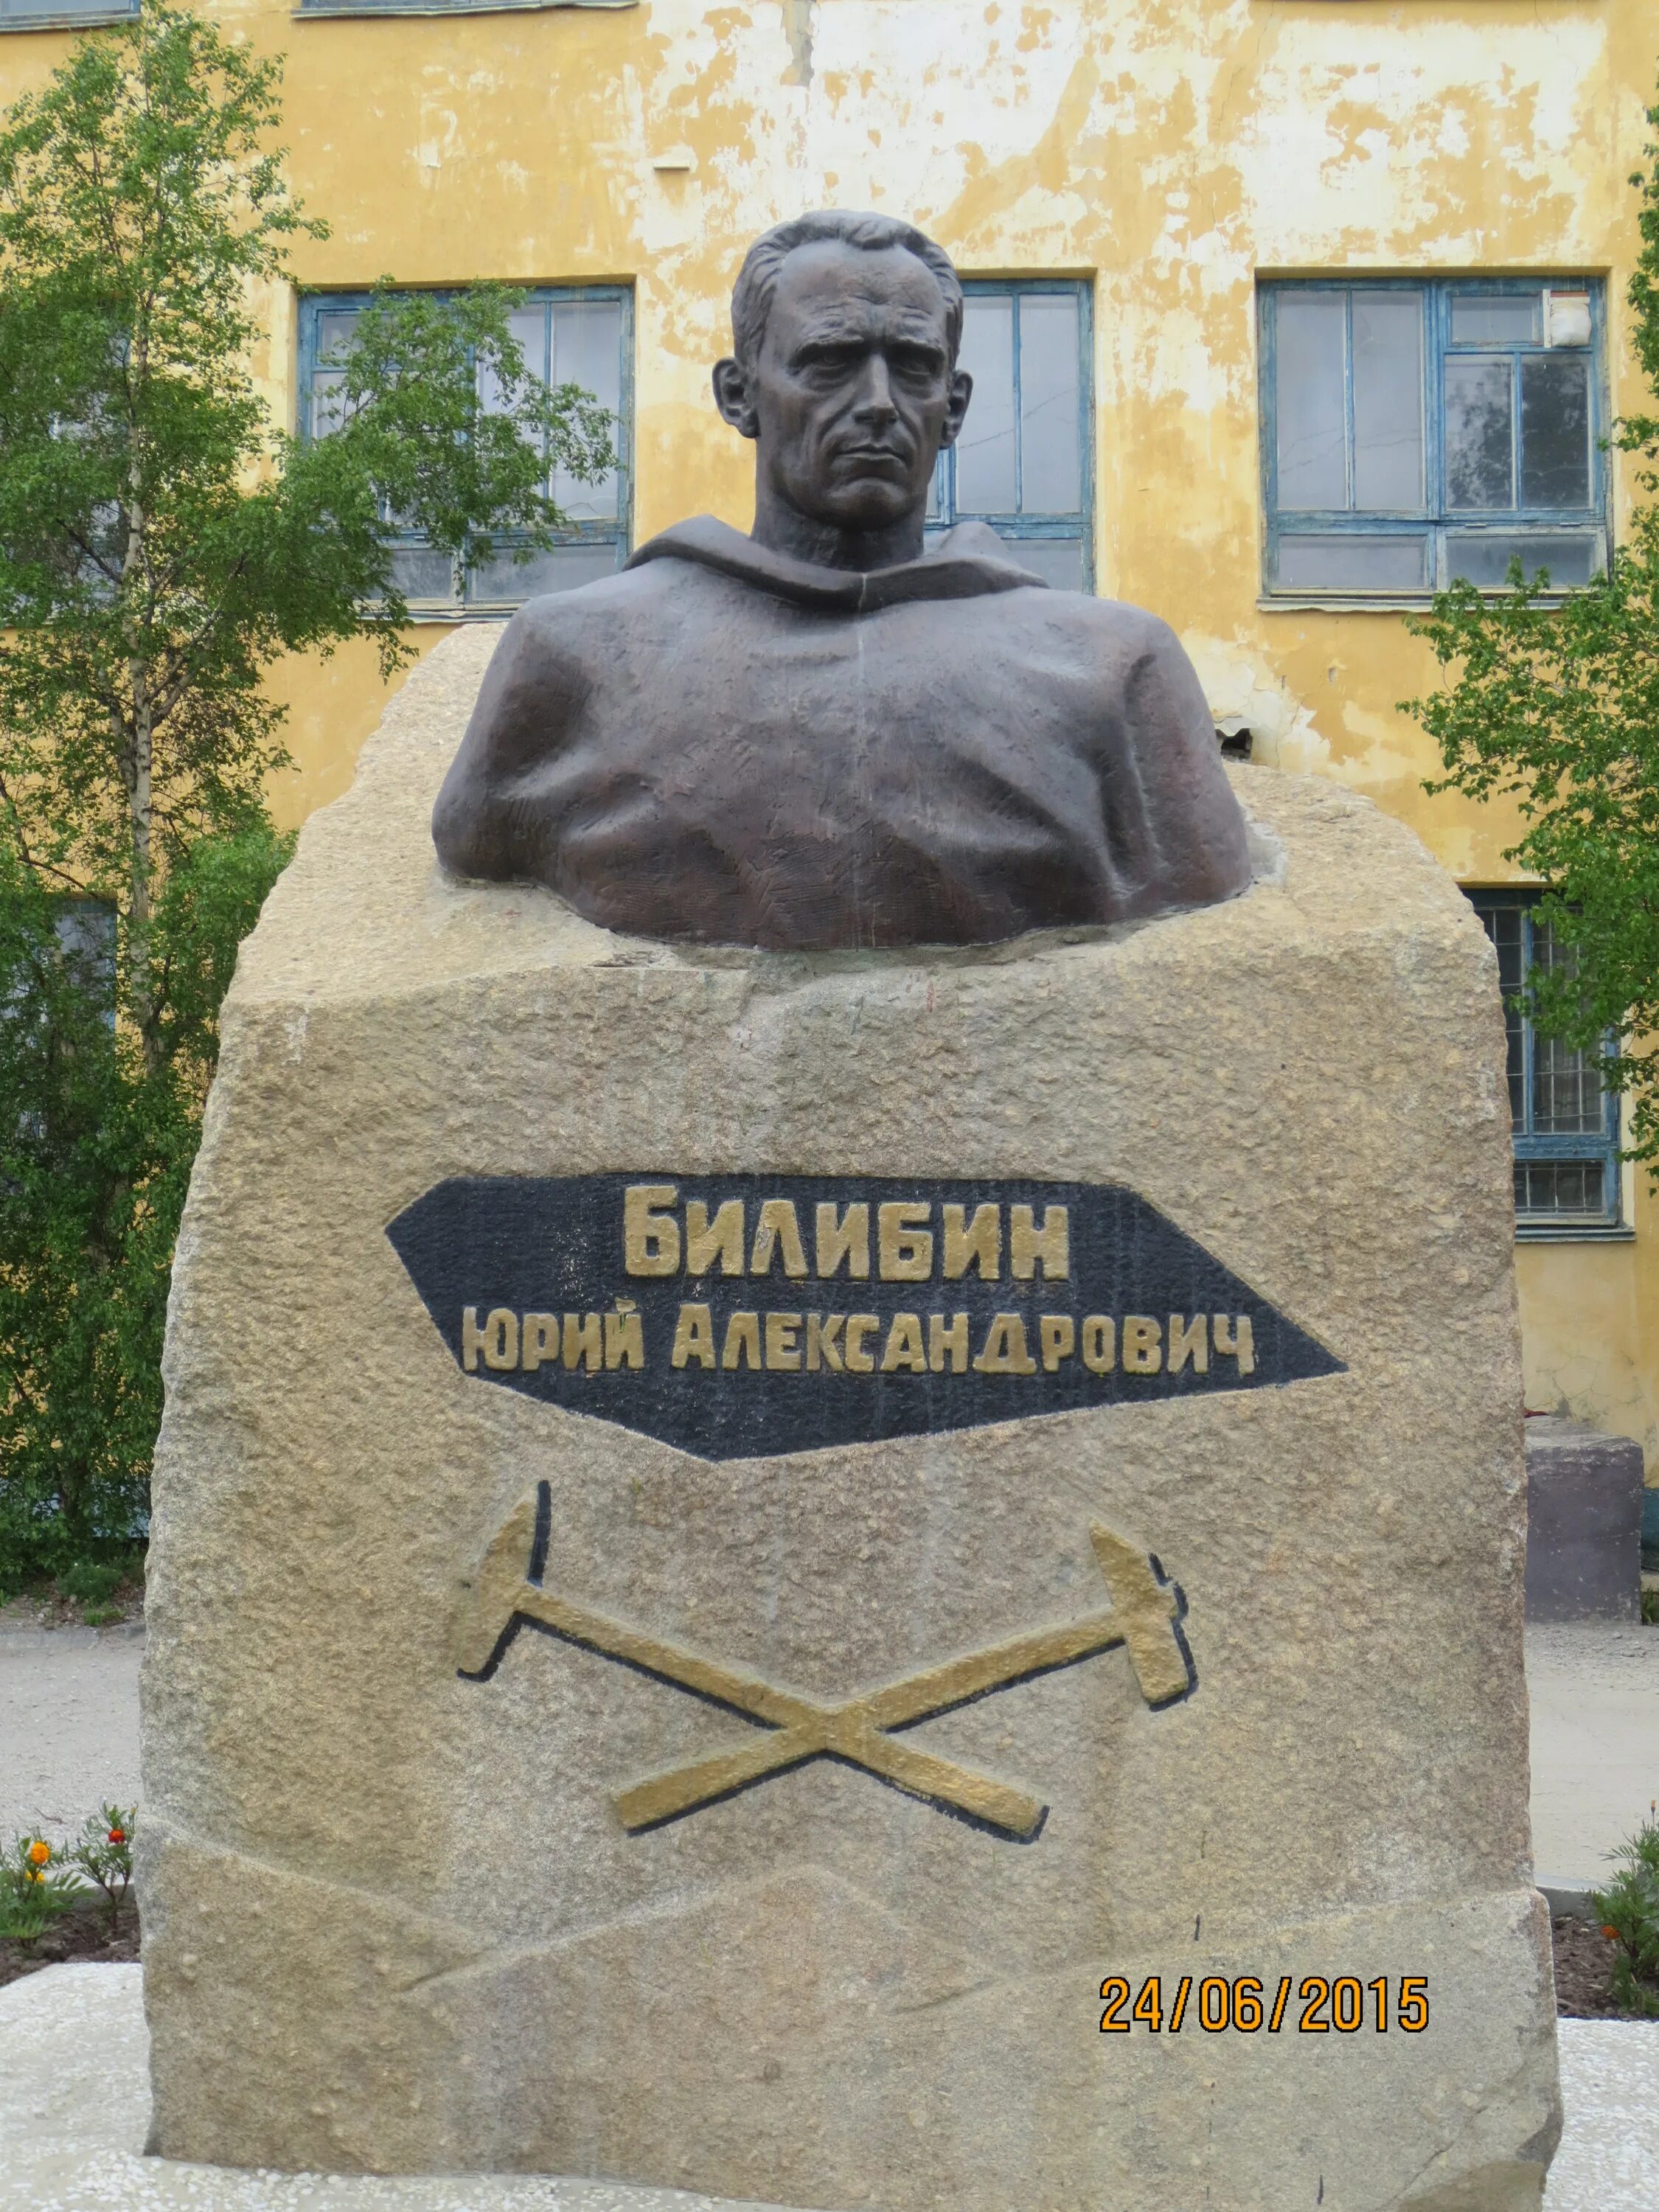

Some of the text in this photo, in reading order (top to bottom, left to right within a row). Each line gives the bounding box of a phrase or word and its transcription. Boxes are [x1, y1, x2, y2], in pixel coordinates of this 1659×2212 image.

[625, 1185, 1069, 1281] БИЛИБИН
[462, 1298, 1254, 1376] ЮРИЙ АЛЕКСАНДРОВИЧ
